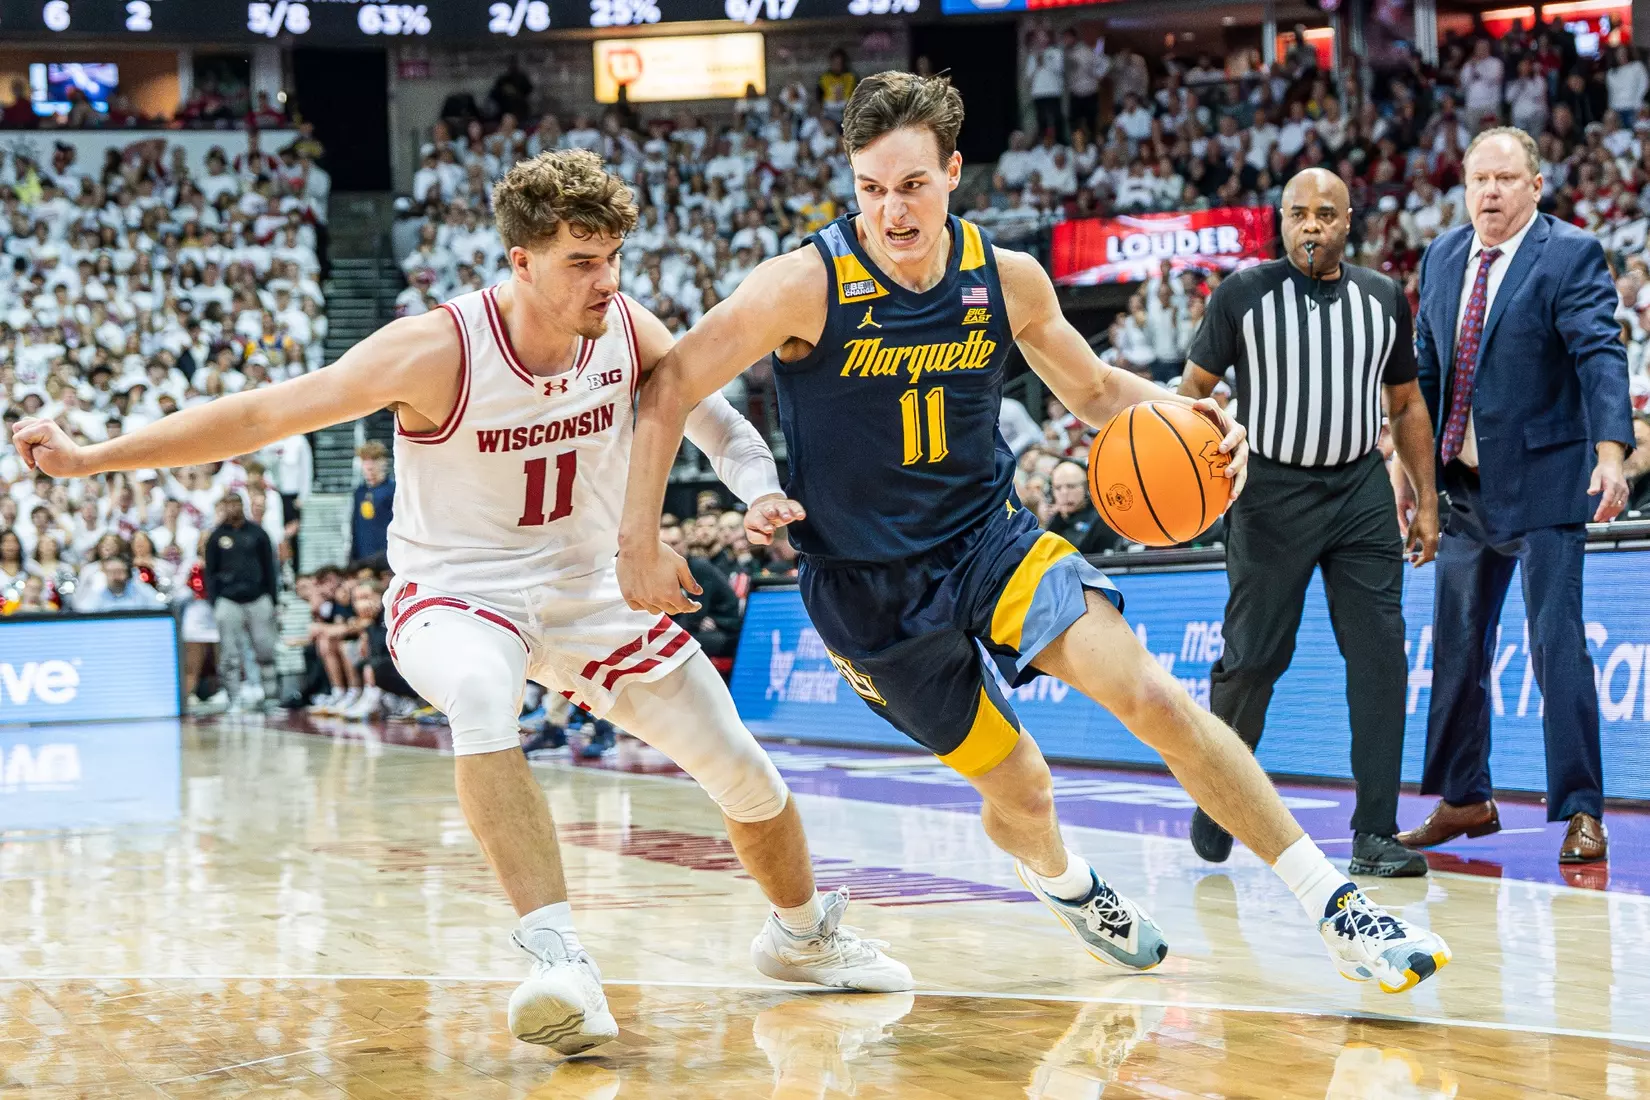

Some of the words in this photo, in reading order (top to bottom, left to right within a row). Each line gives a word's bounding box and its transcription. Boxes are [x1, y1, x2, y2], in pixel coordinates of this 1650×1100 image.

[43, 0, 71, 31] 6
[125, 0, 153, 32] 2
[247, 0, 311, 37] 5/8
[357, 4, 431, 35] 63%
[488, 0, 550, 36] 2/8
[1106, 226, 1242, 262] LOUDER
[845, 287, 876, 297] CHANGE
[850, 282, 864, 290] BE
[963, 314, 992, 322] EAST
[840, 329, 996, 384] Marquette
[476, 403, 615, 453] WISCONSIN
[899, 386, 949, 466] 11
[517, 450, 577, 527] 11
[0, 659, 80, 705] ve
